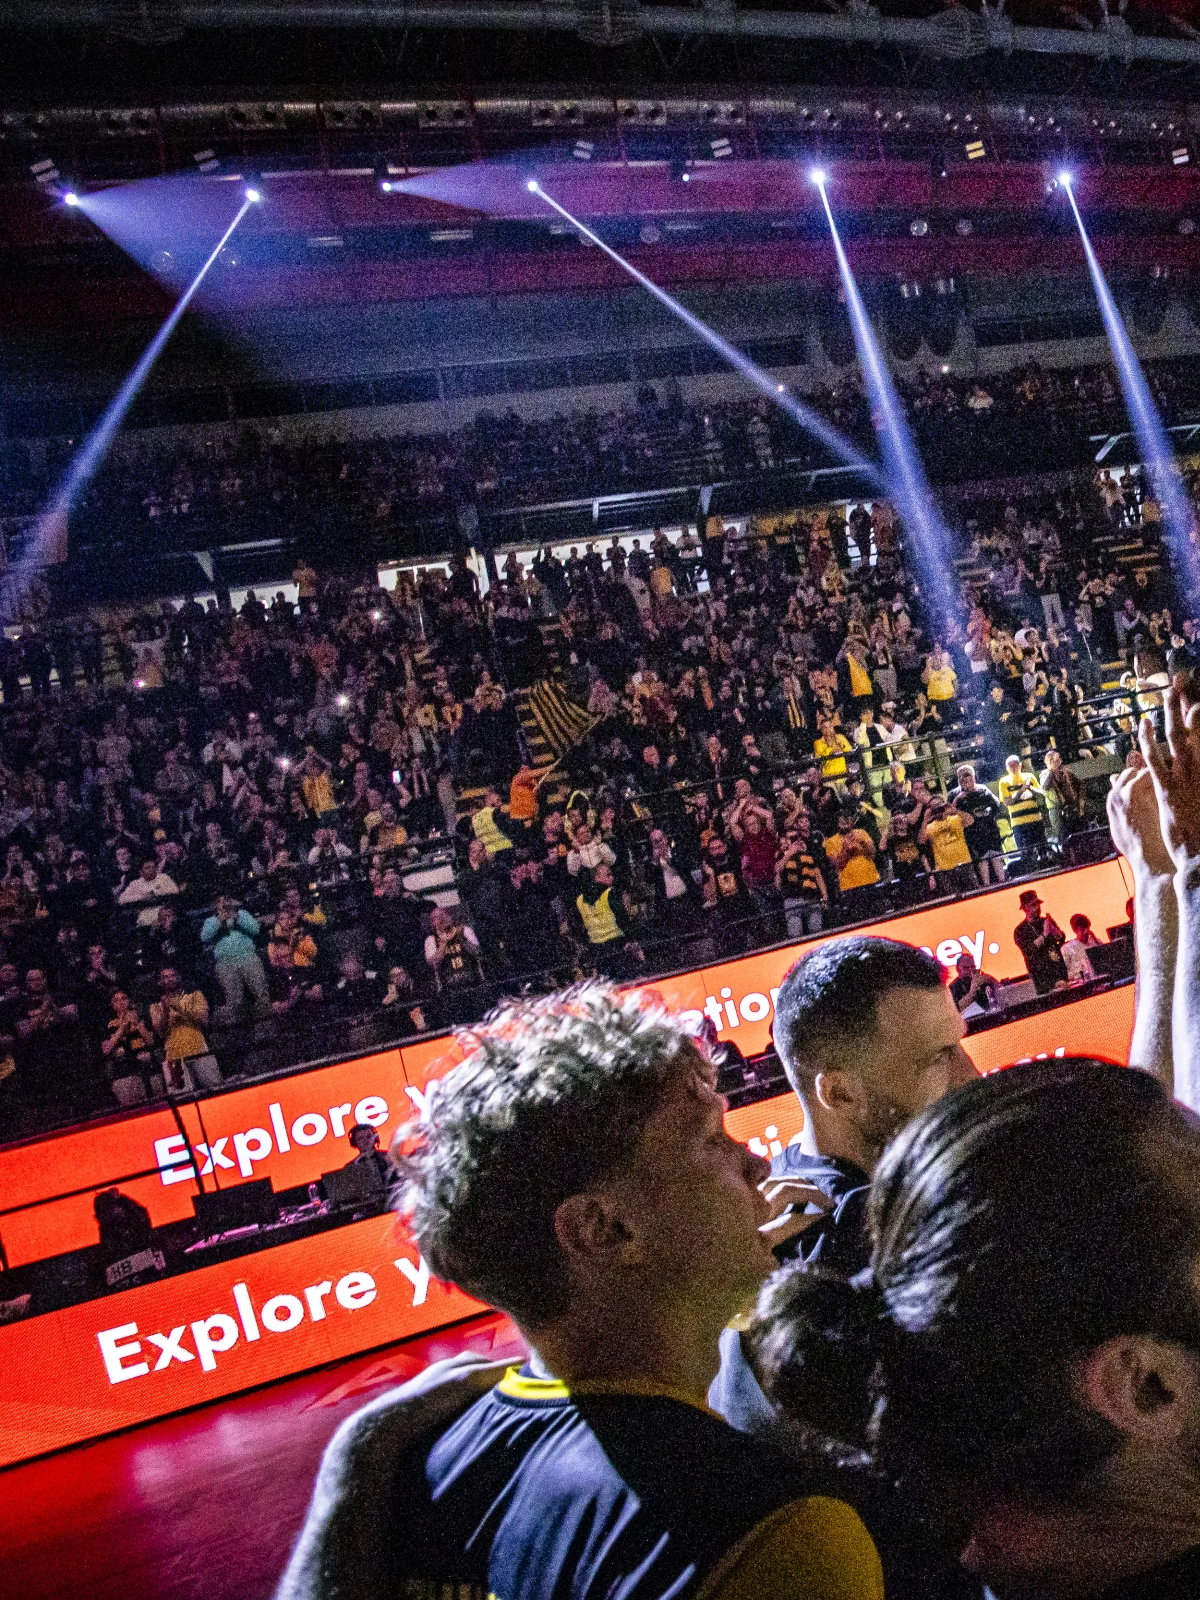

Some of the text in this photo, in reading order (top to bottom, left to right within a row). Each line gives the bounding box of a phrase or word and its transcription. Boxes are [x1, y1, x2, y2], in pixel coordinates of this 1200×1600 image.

[919, 930, 1000, 970] ey.
[154, 1096, 390, 1187] Explore
[97, 1271, 378, 1386] Explore
